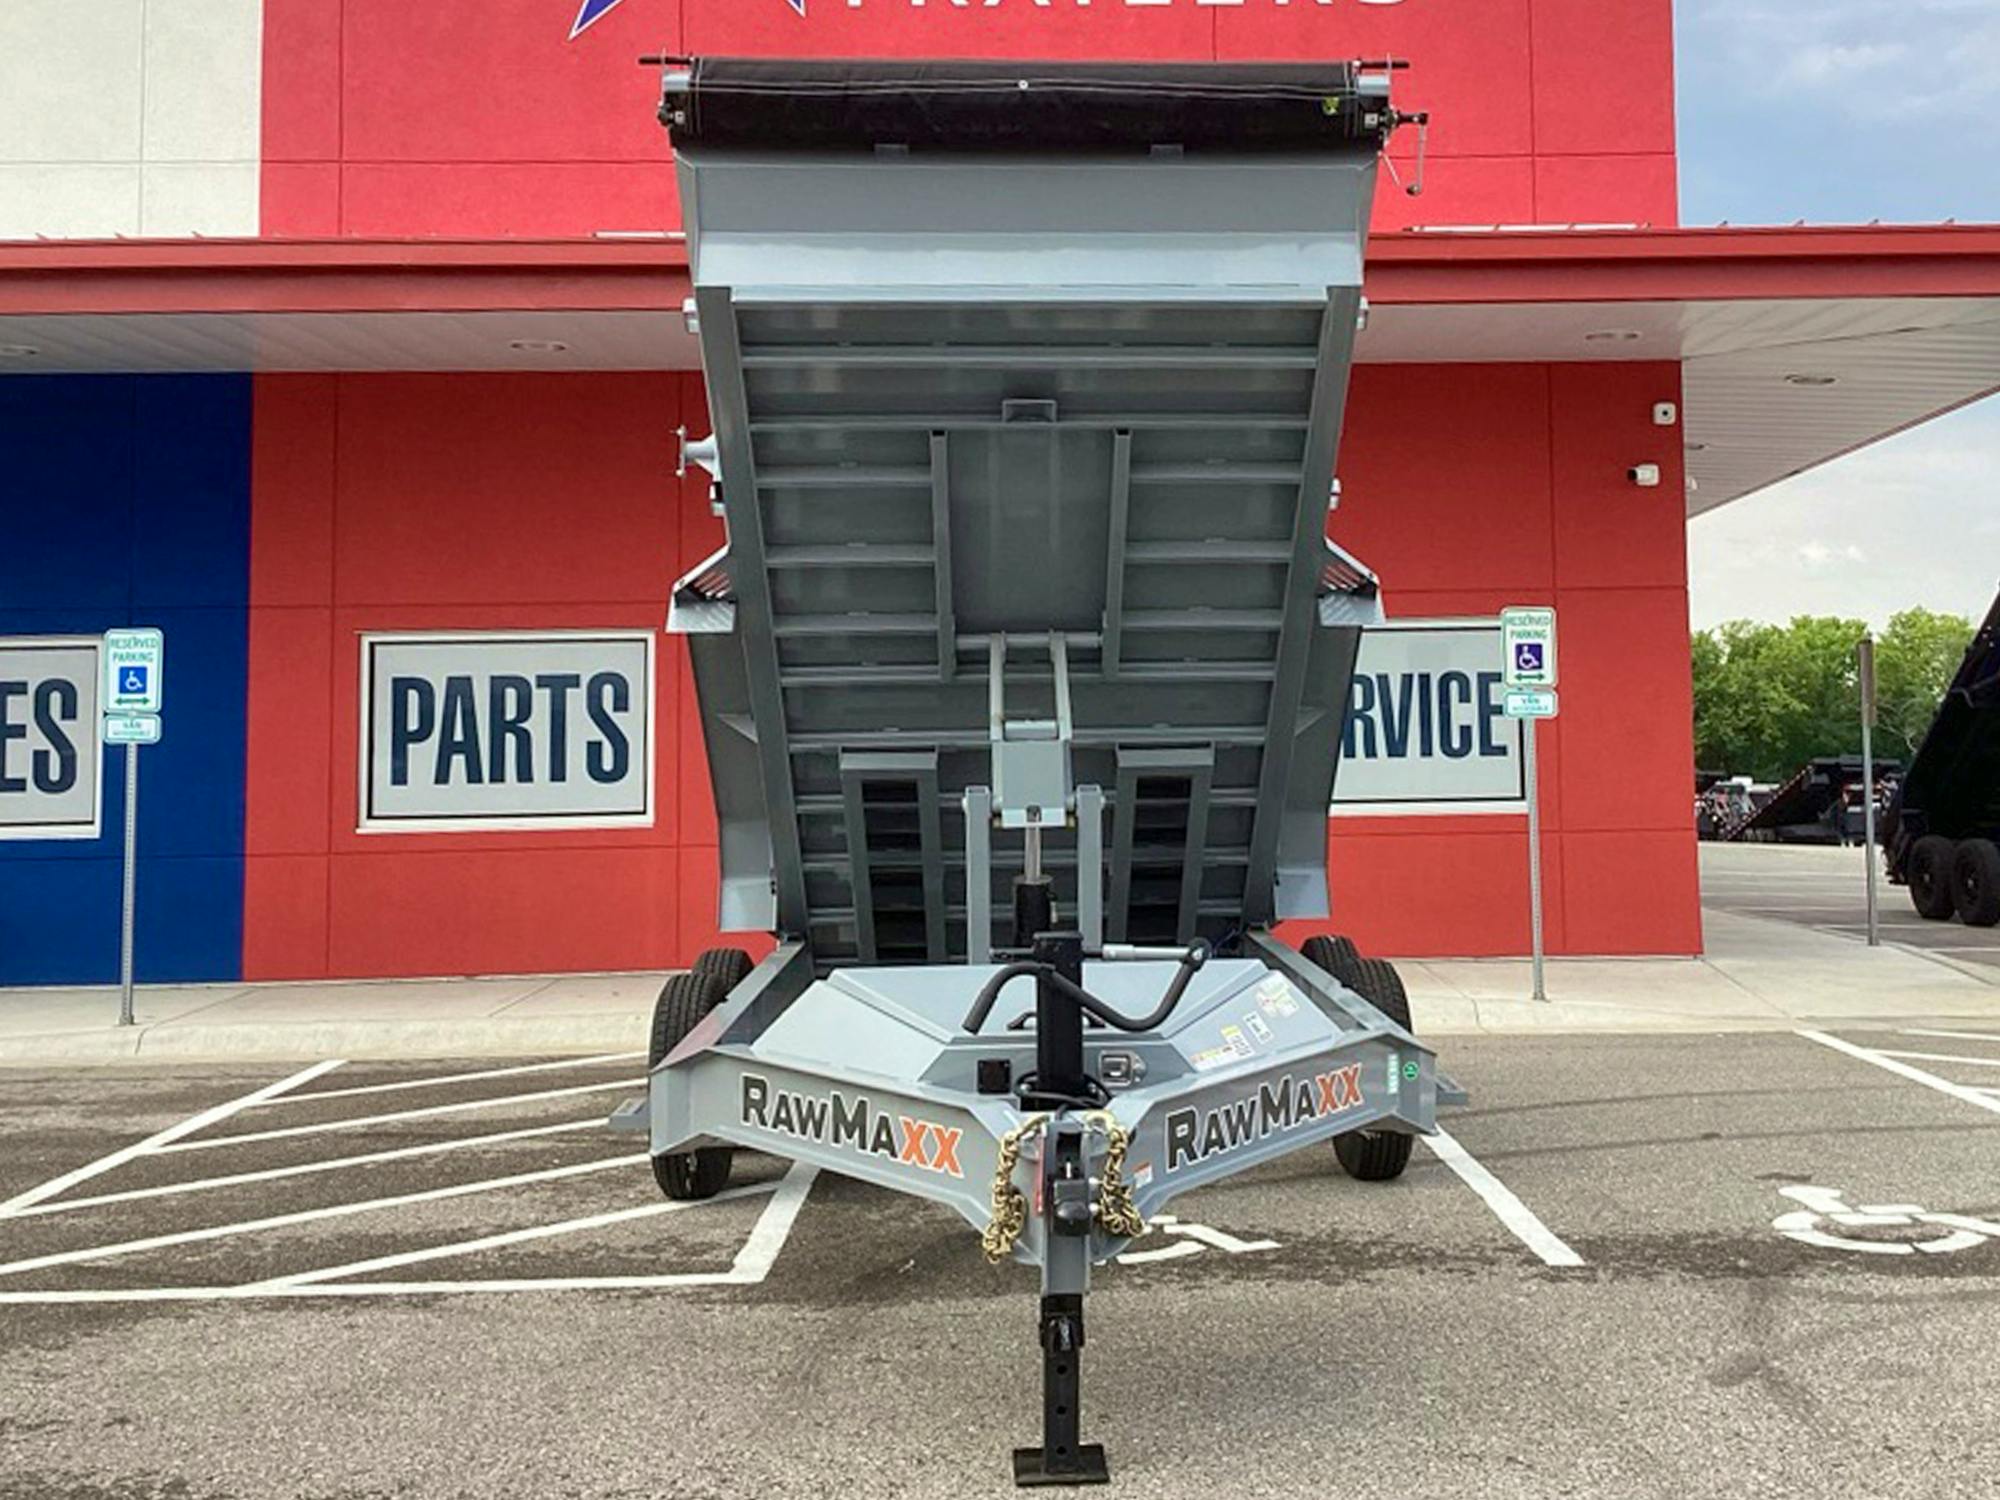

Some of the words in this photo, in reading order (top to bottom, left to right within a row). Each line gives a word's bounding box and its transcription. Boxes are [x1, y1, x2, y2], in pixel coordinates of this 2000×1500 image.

[1506, 614, 1551, 626] RESERVED
[1511, 629, 1548, 640] PARKING
[110, 637, 157, 648] RESERVED
[113, 651, 153, 662] PARKING
[1343, 670, 1508, 759] RVICE
[390, 672, 630, 786] PARTS
